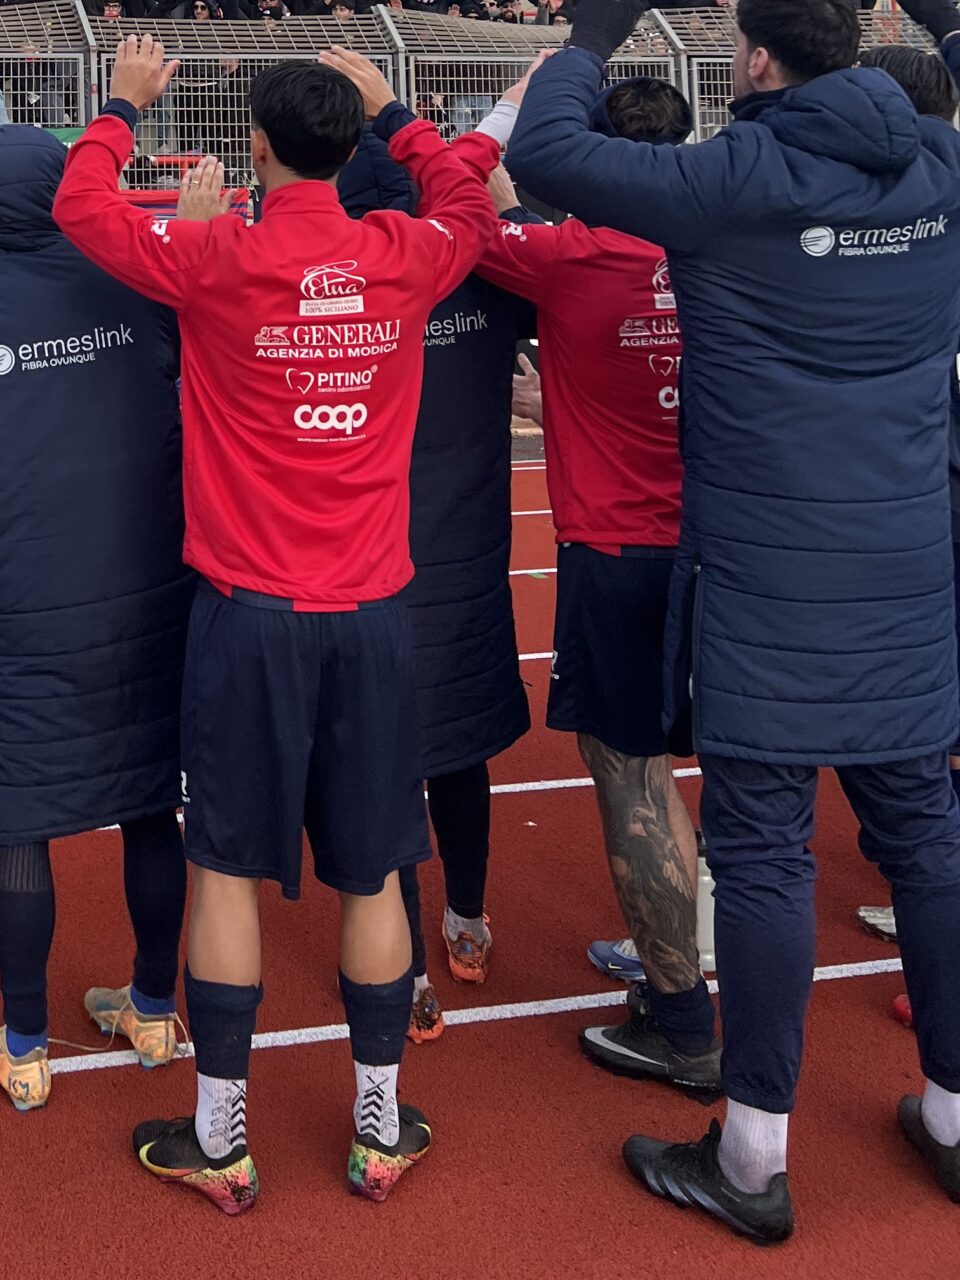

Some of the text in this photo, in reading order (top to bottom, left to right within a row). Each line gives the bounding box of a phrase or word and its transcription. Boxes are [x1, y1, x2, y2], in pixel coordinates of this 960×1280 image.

[839, 214, 948, 245] ermeslink
[839, 243, 909, 256] FIBRA OVUNQUE
[293, 320, 401, 346] GENERALI
[425, 309, 488, 336] eslink
[18, 323, 134, 361] ermeslink
[256, 341, 398, 359] AGENZIA DI MODICA
[620, 336, 679, 347] AGENZIA
[22, 352, 95, 371] FIBRA OVUNQUE
[318, 370, 372, 387] PITINO
[293, 403, 368, 435] coop
